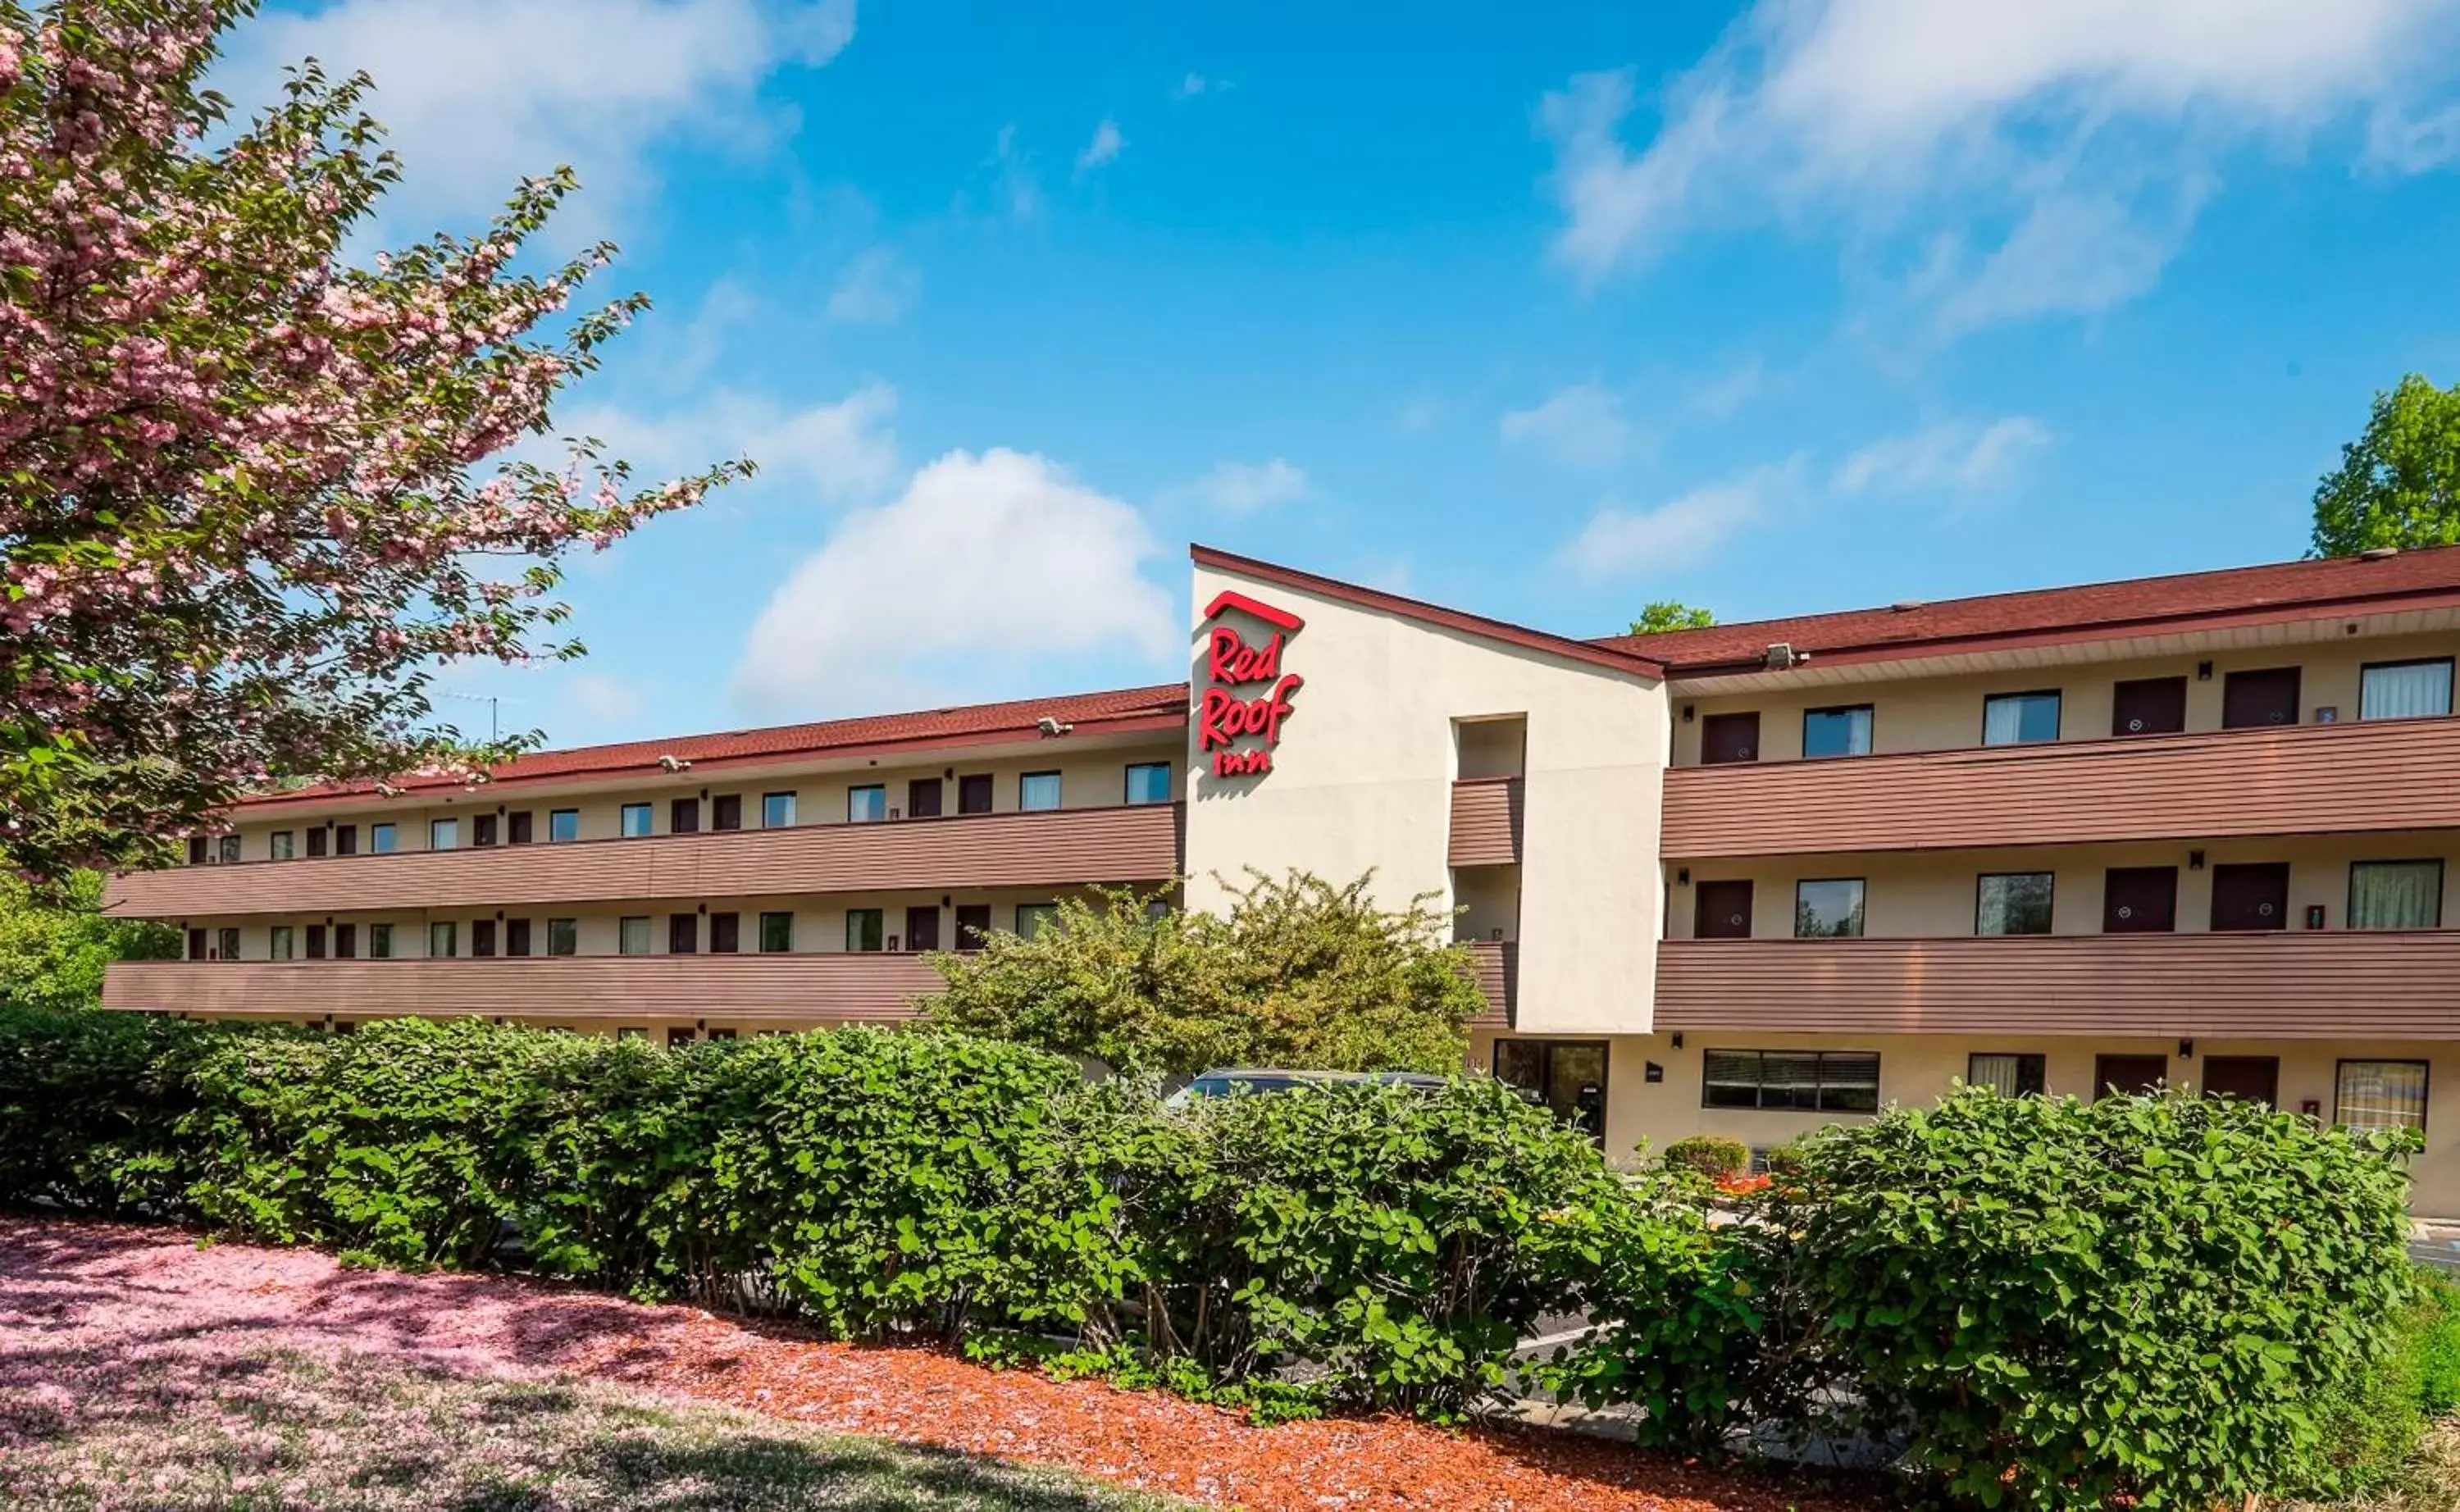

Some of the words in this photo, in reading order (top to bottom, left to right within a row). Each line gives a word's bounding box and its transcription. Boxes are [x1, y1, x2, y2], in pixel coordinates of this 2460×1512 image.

[1210, 627, 1282, 685] Red
[1199, 674, 1300, 752] Roof
[1213, 749, 1271, 776] Inn
